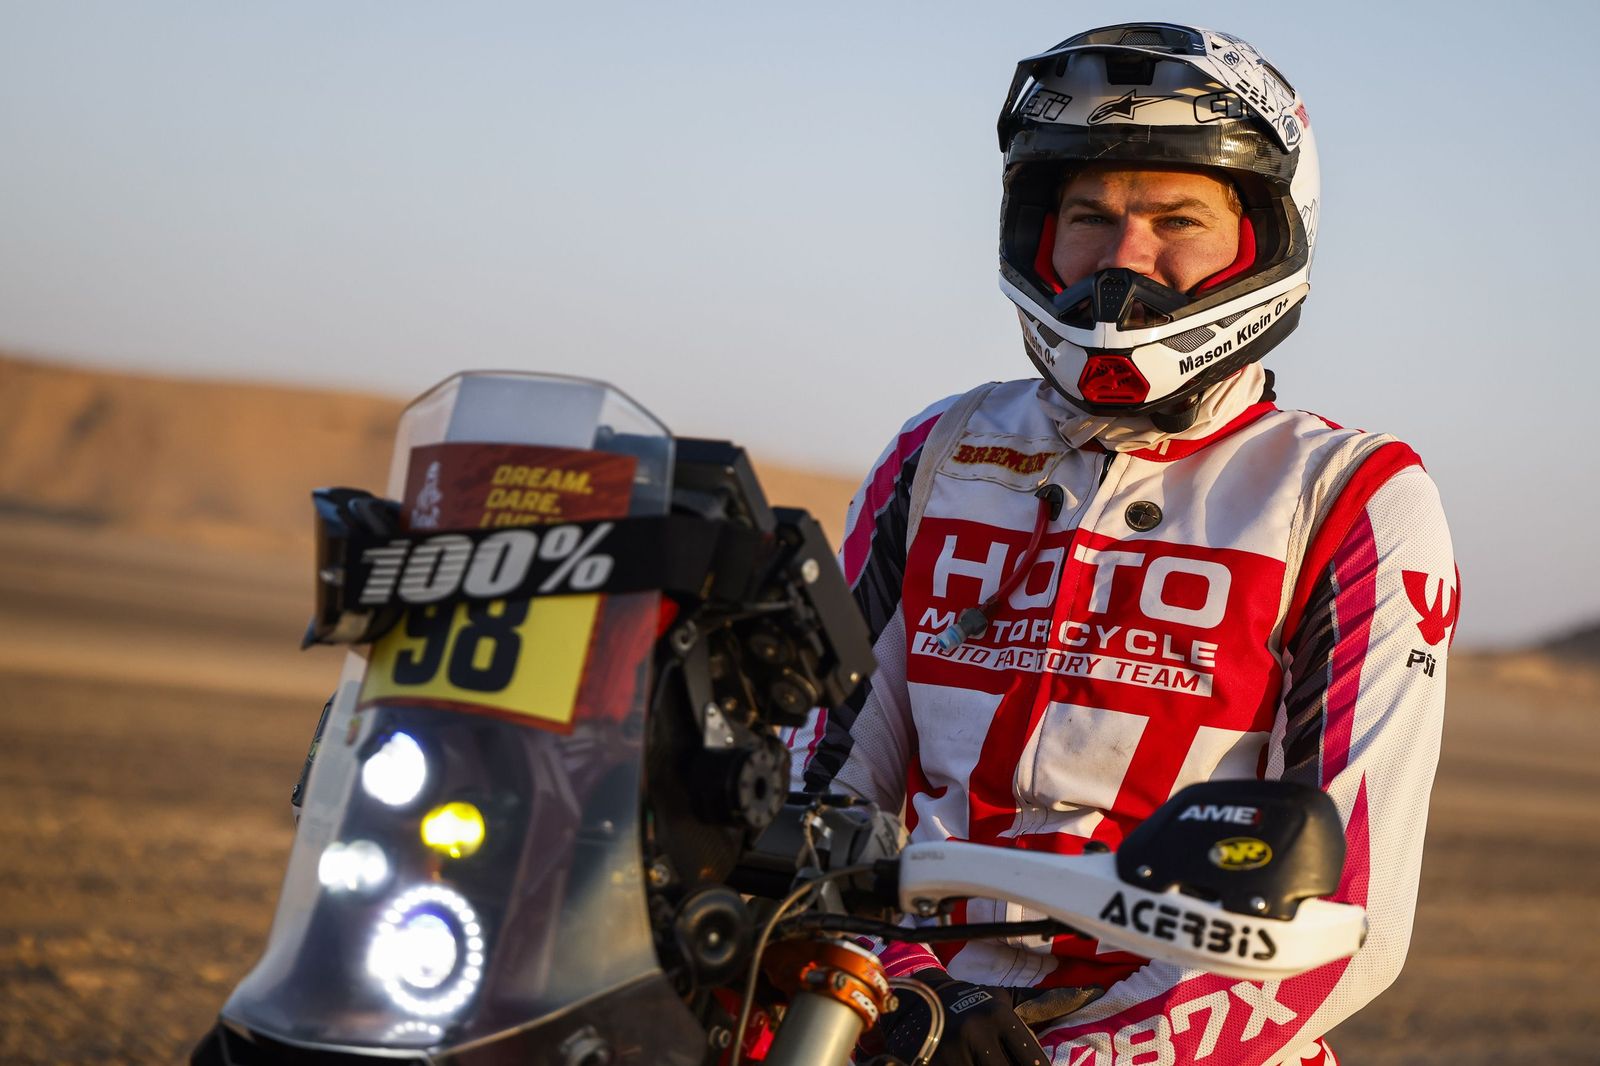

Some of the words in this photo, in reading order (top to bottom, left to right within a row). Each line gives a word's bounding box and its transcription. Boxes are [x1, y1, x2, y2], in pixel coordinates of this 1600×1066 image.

[1179, 339, 1232, 375] Mason
[1236, 312, 1271, 346] Klein
[492, 465, 593, 495] DREAM.
[358, 522, 616, 605] 100%
[932, 534, 1232, 629] HOTO
[391, 597, 531, 693] 98
[918, 607, 1219, 668] MTORCYCLE
[993, 648, 1101, 675] FACTORY
[1115, 661, 1200, 692] TEAM
